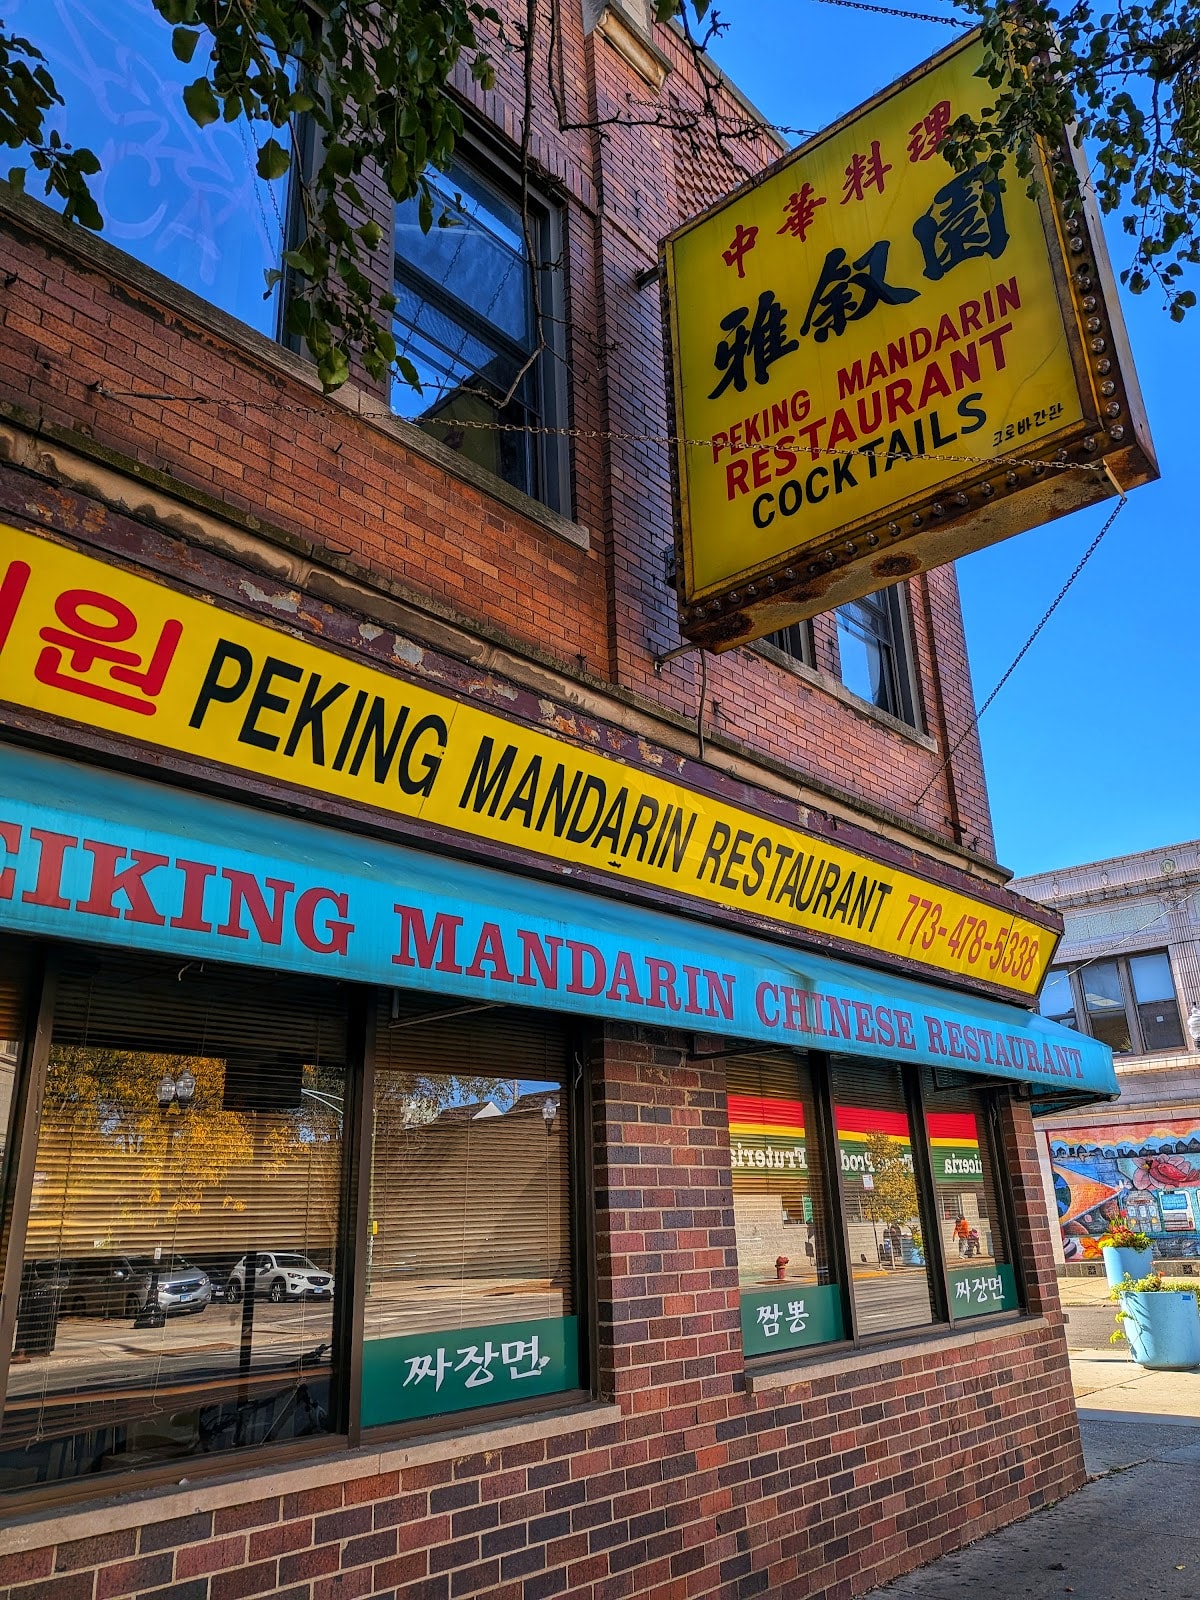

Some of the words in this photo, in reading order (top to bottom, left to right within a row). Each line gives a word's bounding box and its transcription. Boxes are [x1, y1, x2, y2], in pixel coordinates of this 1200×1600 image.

[722, 100, 953, 279] 中華料理
[712, 389, 811, 465] PEKING
[837, 276, 1022, 394] MANDARIN
[726, 323, 1014, 501] RESTAURANT
[752, 393, 988, 529] COCKTAILS
[0, 560, 183, 716] 원
[188, 637, 447, 797] PEKING
[458, 735, 698, 873] MANDARIN
[696, 821, 893, 933] RESTAURANT
[896, 894, 1040, 982] 773-478-5338
[392, 903, 736, 1021] MANDARIN
[755, 981, 915, 1050] CHINESE
[923, 1015, 1084, 1079] RESTAURANT
[403, 1335, 541, 1391] 짜장면
[755, 1299, 810, 1337] 짬뽕
[954, 1274, 1005, 1304] 짜장면
